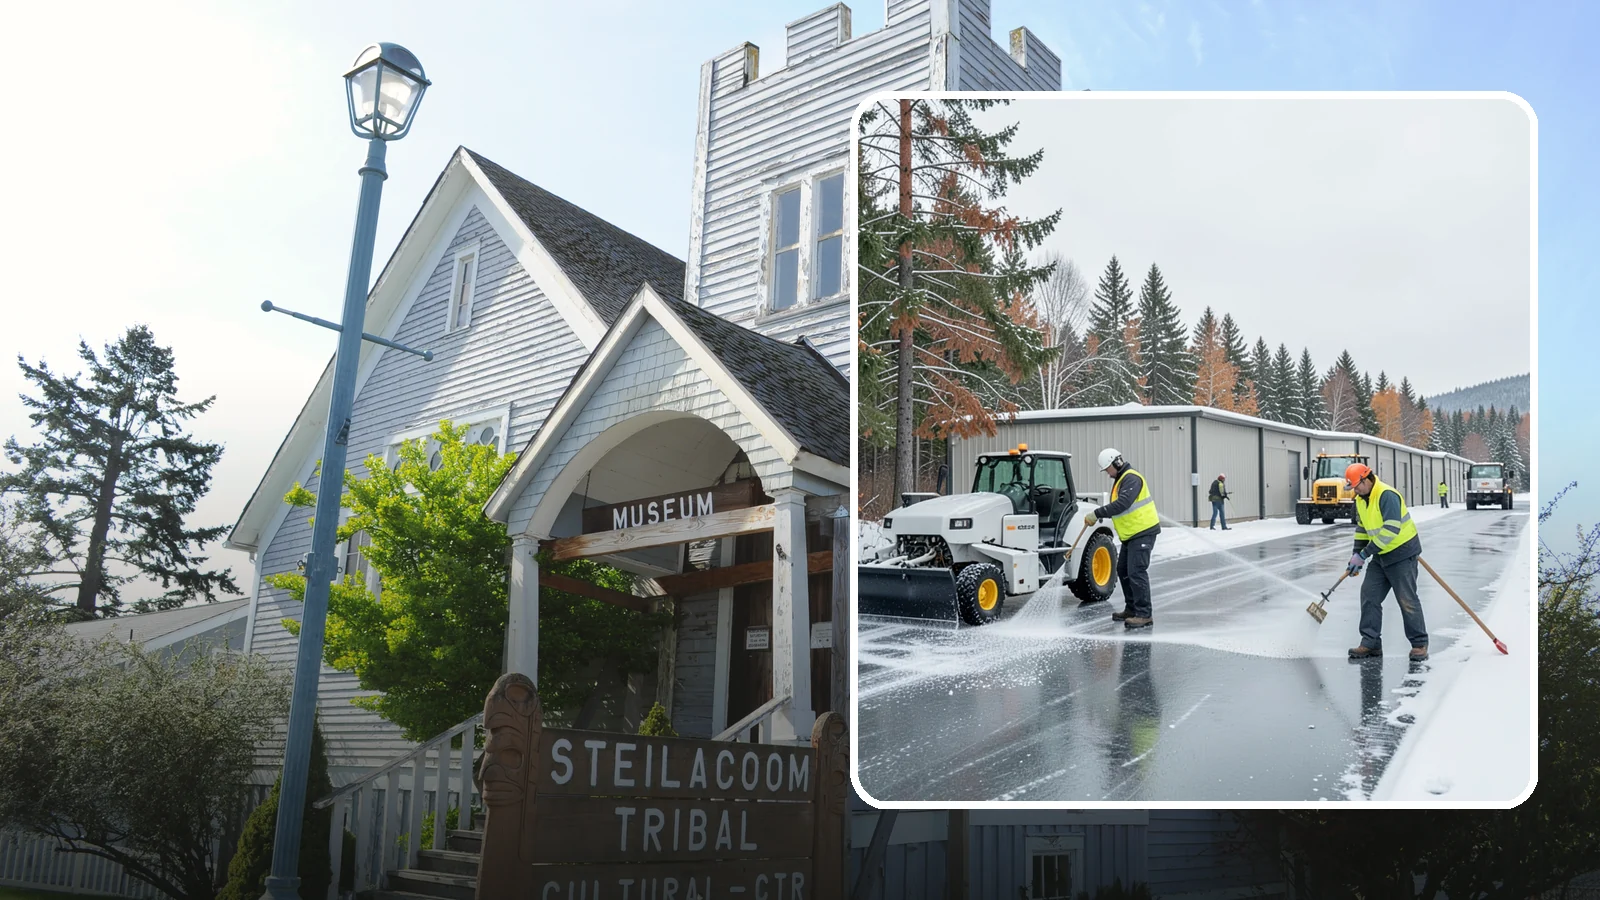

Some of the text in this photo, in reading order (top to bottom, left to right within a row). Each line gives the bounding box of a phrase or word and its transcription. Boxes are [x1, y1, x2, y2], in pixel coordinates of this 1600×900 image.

[613, 491, 713, 531] MUSEUM
[551, 738, 809, 792] STEILACOOM
[615, 806, 758, 852] TRIBAL
